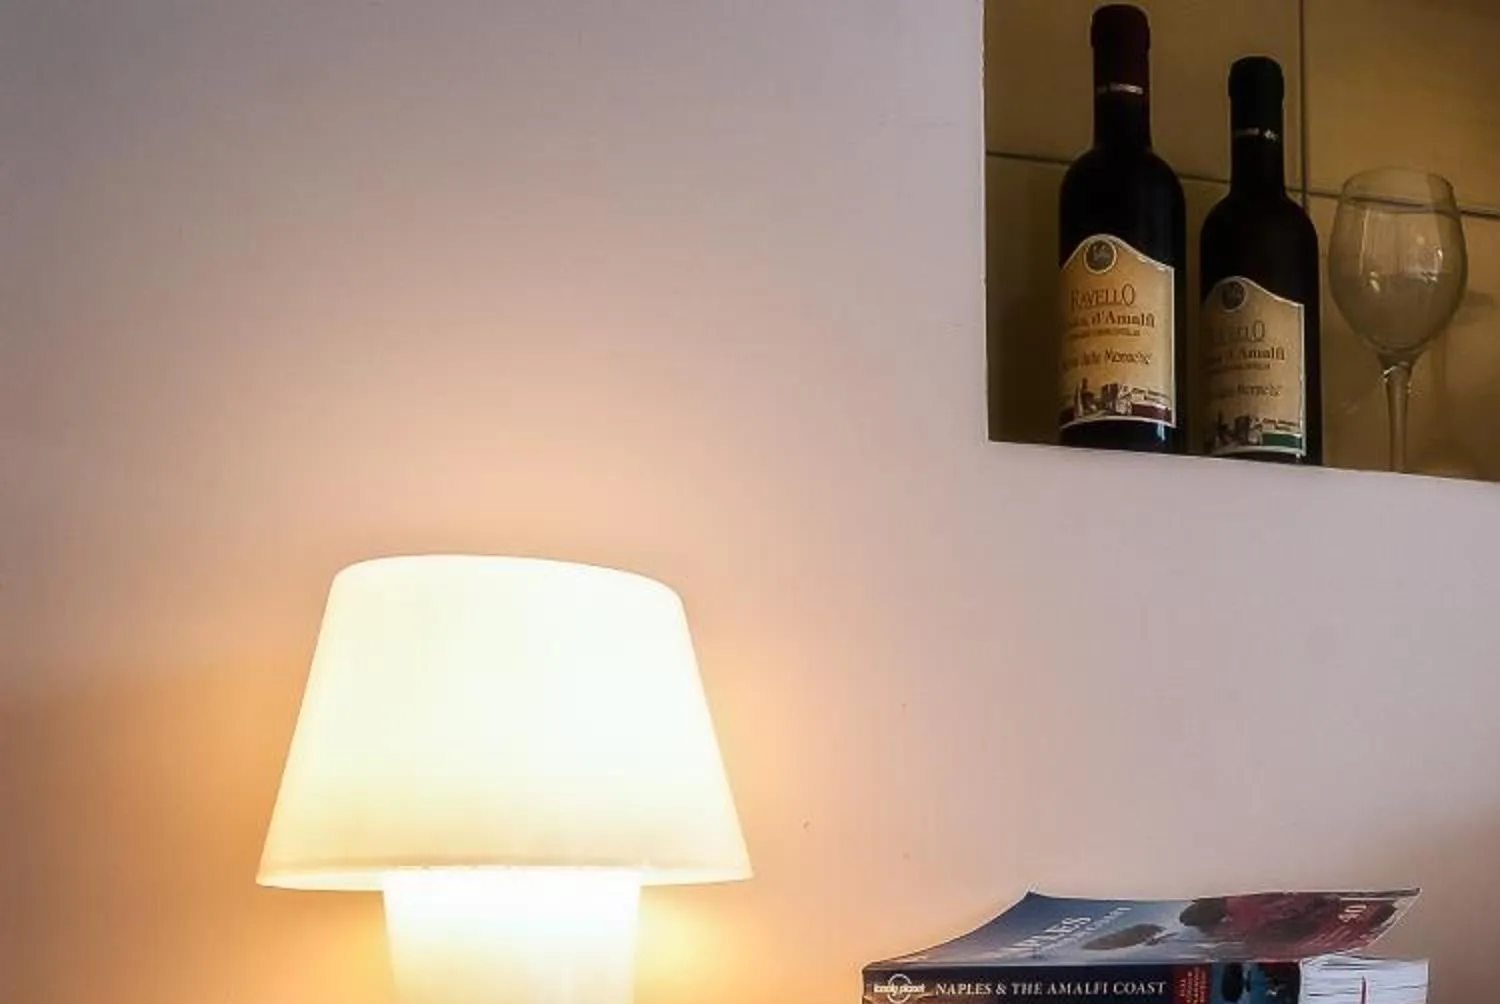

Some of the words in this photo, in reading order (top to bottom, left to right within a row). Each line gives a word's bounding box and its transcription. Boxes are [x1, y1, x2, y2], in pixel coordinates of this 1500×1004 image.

[935, 982, 991, 996] NAPLES
[996, 982, 1007, 995] &
[1011, 983, 1043, 996] THE
[1047, 981, 1108, 995] AMALFI
[1113, 980, 1167, 994] COAST
